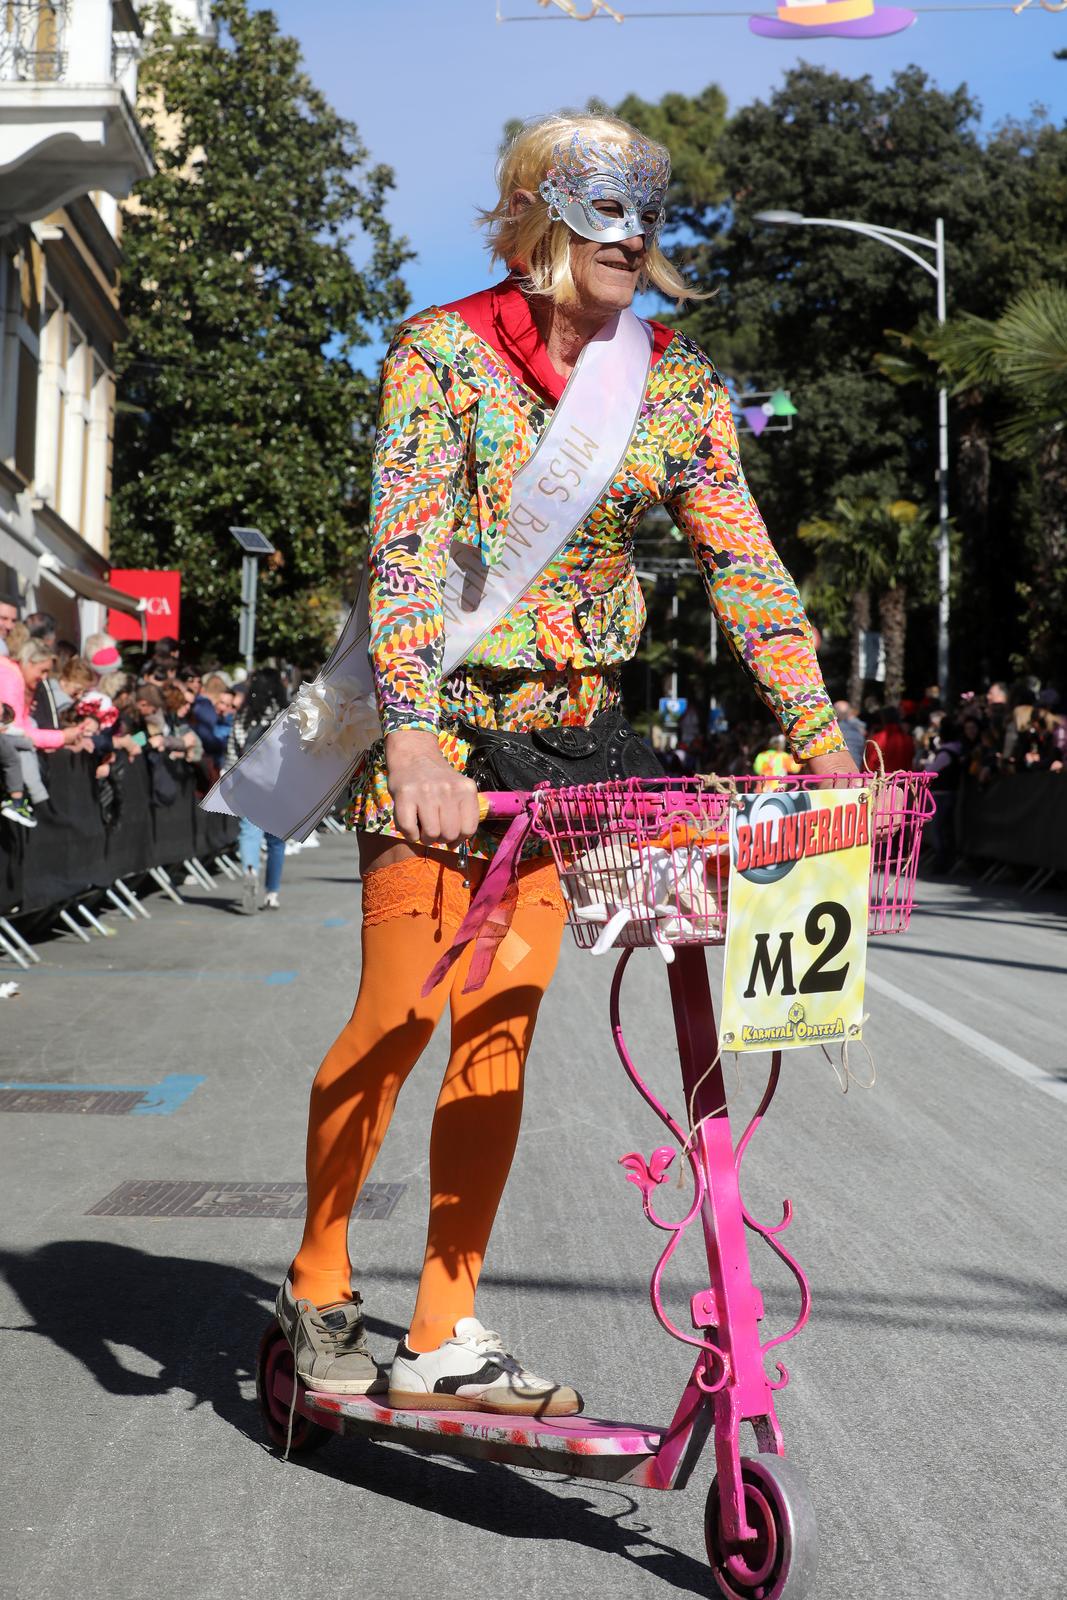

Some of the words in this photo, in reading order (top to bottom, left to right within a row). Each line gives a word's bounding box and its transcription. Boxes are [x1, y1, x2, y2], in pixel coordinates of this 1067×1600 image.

[538, 424, 600, 503] MISS
[736, 801, 869, 872] BALINJERADA
[743, 900, 852, 998] M2
